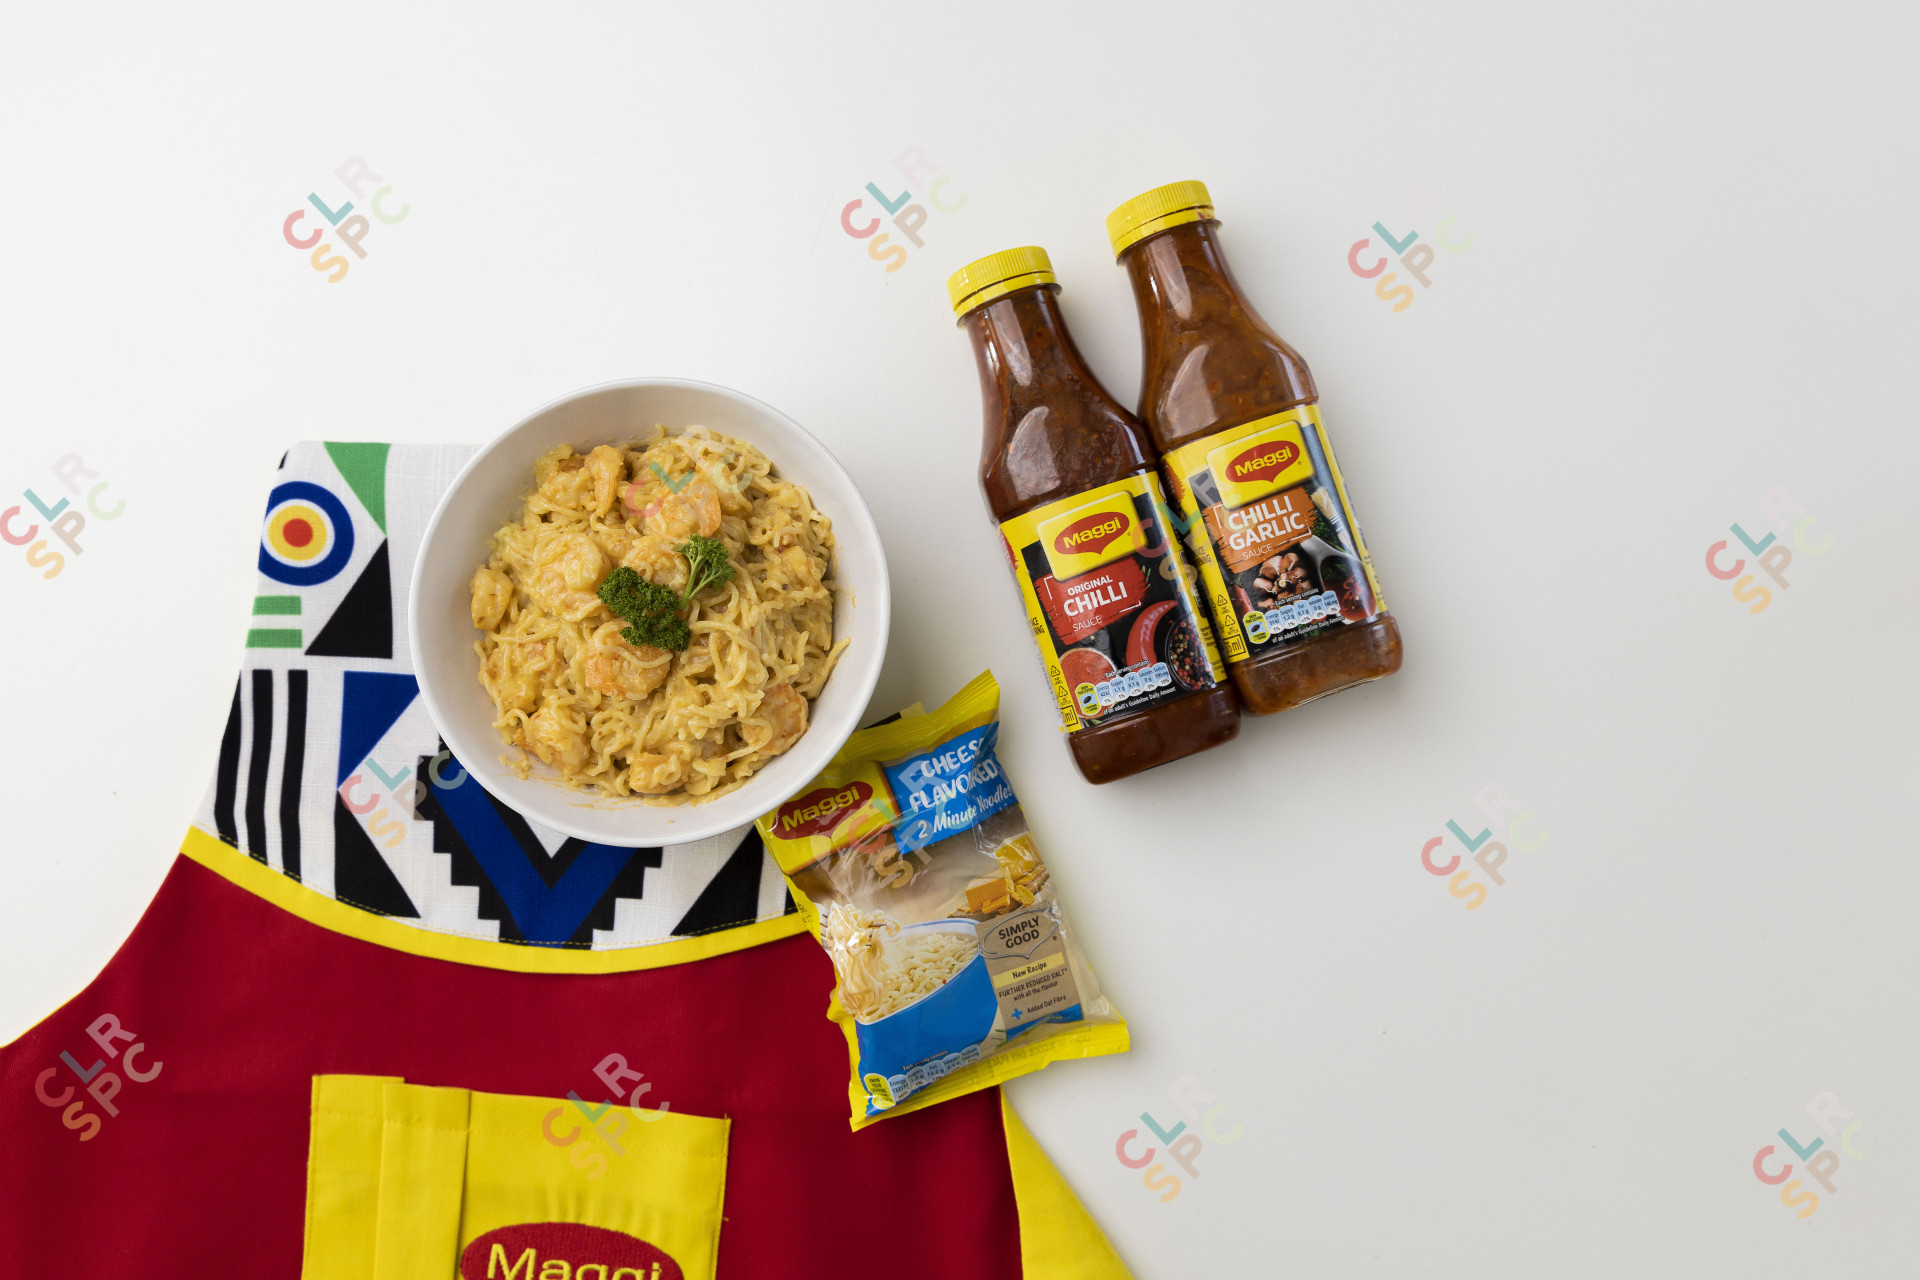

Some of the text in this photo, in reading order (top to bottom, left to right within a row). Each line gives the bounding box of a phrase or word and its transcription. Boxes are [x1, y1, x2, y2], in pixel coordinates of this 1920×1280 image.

[1235, 446, 1292, 477] Maggi
[1228, 495, 1292, 531] CHILLI
[1063, 517, 1121, 549] Maggi
[1229, 512, 1304, 551] GARLIC
[1242, 543, 1273, 561] SAUCE
[1068, 574, 1113, 597] ORIGINAL
[1063, 582, 1128, 617] CHILLI
[1072, 616, 1103, 633] SAUCE
[920, 736, 987, 778] CHEES
[781, 786, 861, 832] Maggi
[917, 784, 1014, 839] 2 Minute Noodles
[998, 916, 1040, 940] SIMPLY
[1005, 929, 1040, 949] GOOD
[1012, 962, 1048, 980] New Recipe
[998, 984, 1025, 999] FURTHER
[1025, 974, 1051, 988] REDUCED
[1013, 980, 1059, 1002] with all the flavour
[1027, 994, 1067, 1014] Added Oat Fibre
